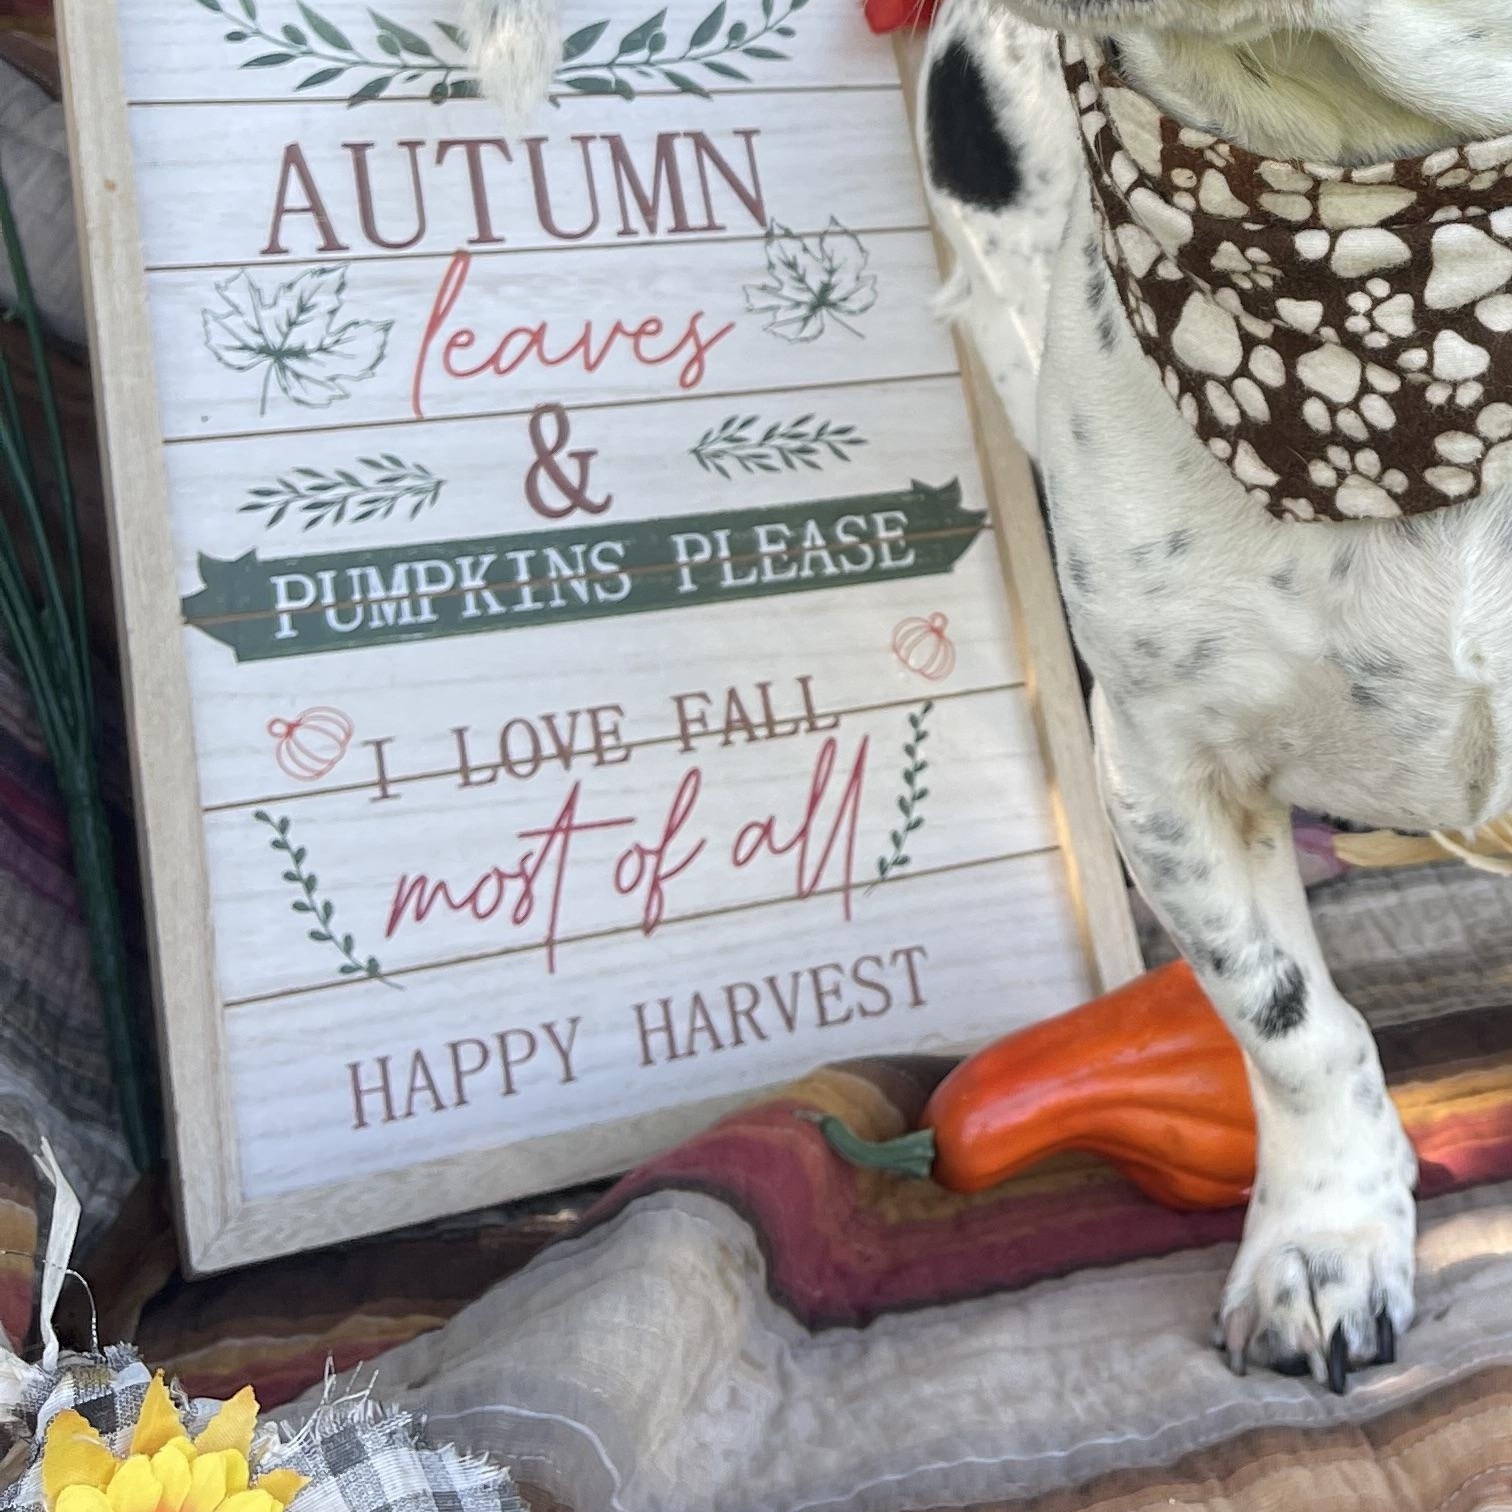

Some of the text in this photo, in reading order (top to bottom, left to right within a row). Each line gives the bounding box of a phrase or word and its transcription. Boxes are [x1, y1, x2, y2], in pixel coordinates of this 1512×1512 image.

[260, 129, 773, 255] AUTUMN
[411, 249, 736, 418] leaves
[523, 402, 613, 518] &
[270, 509, 916, 639] PUMPKINS PLEASE
[360, 675, 843, 802] I LOVE FALL
[384, 734, 870, 974] most of all
[345, 945, 929, 1130] HAPPY HARVEST
